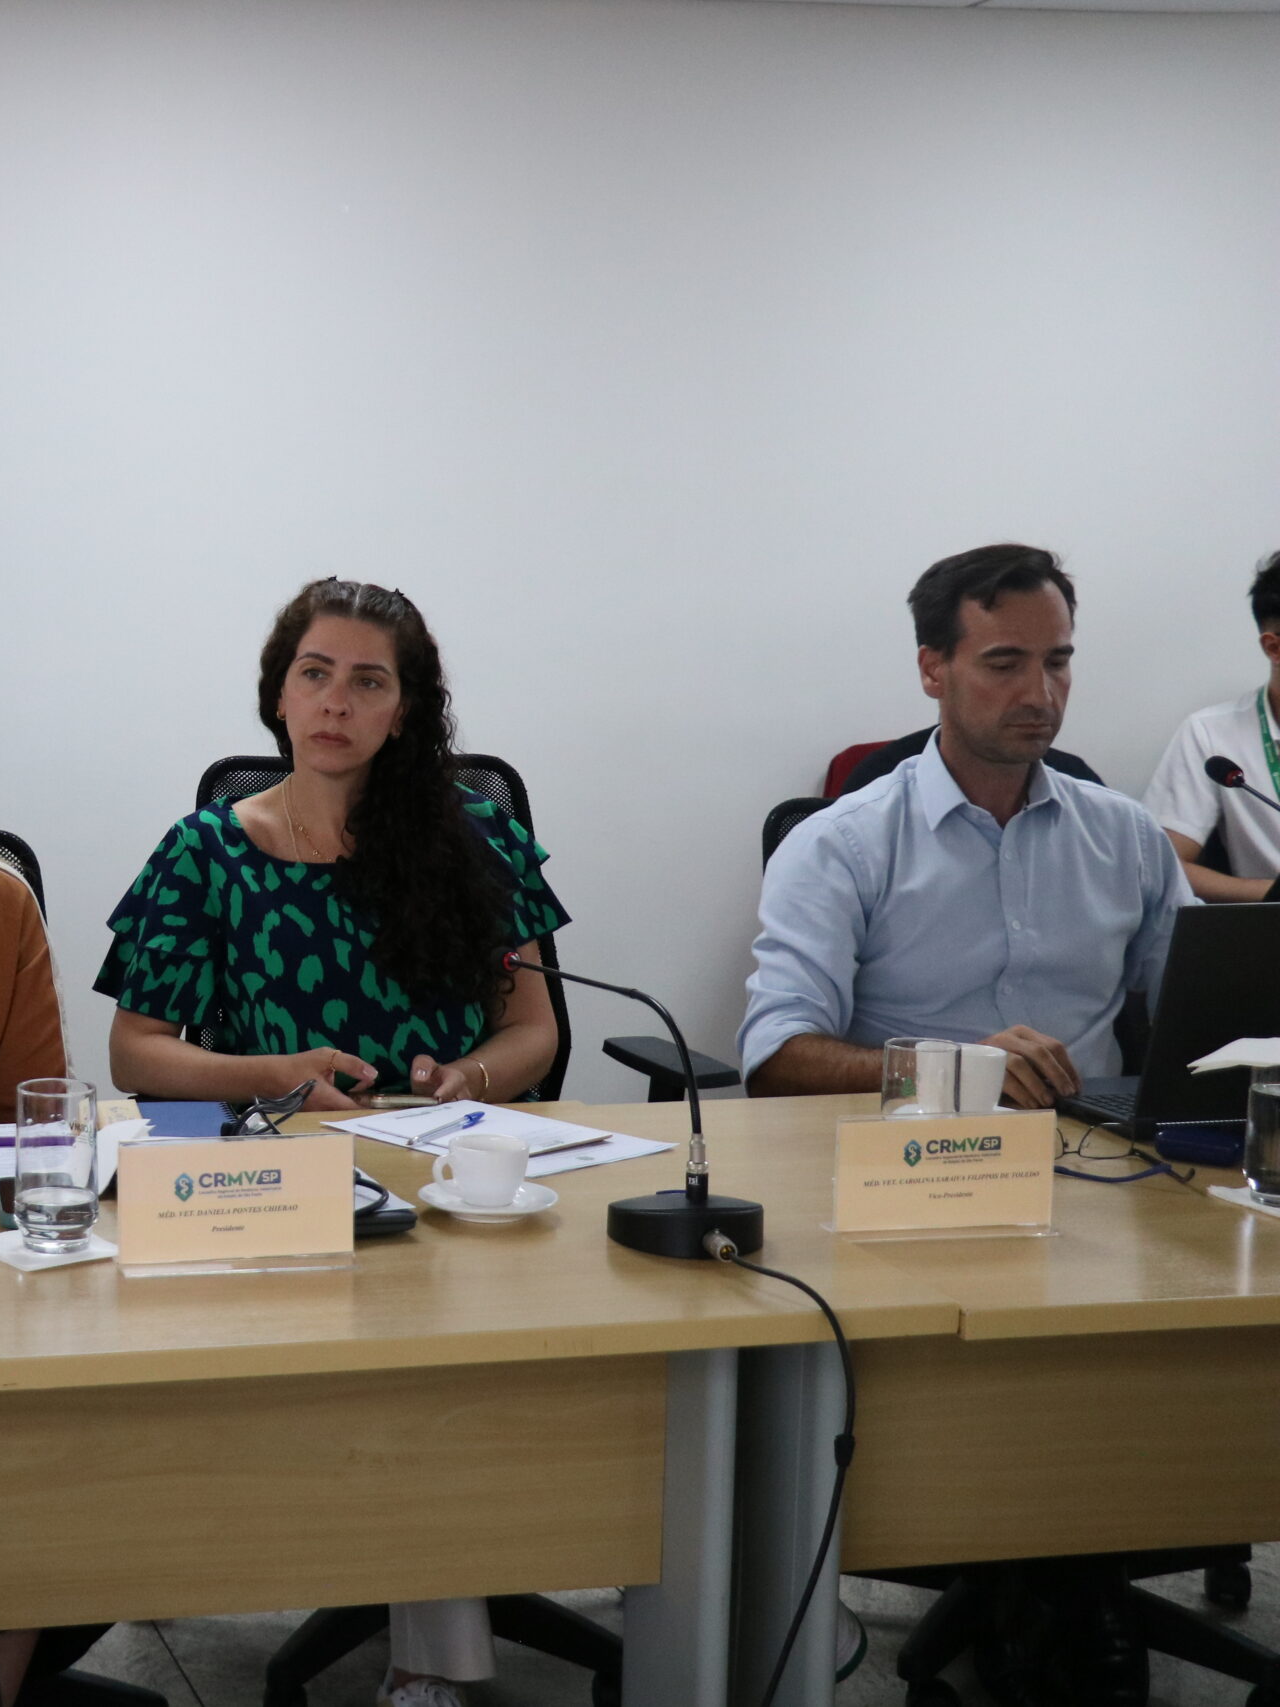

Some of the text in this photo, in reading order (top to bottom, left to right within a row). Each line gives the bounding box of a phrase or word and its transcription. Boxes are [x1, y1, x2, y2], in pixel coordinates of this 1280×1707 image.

[926, 1137, 979, 1154] CRMV
[199, 1171, 257, 1188] CRMV
[197, 1208, 231, 1217] DANIELA
[232, 1206, 262, 1215] PONTES
[211, 1225, 245, 1233] Presidente
